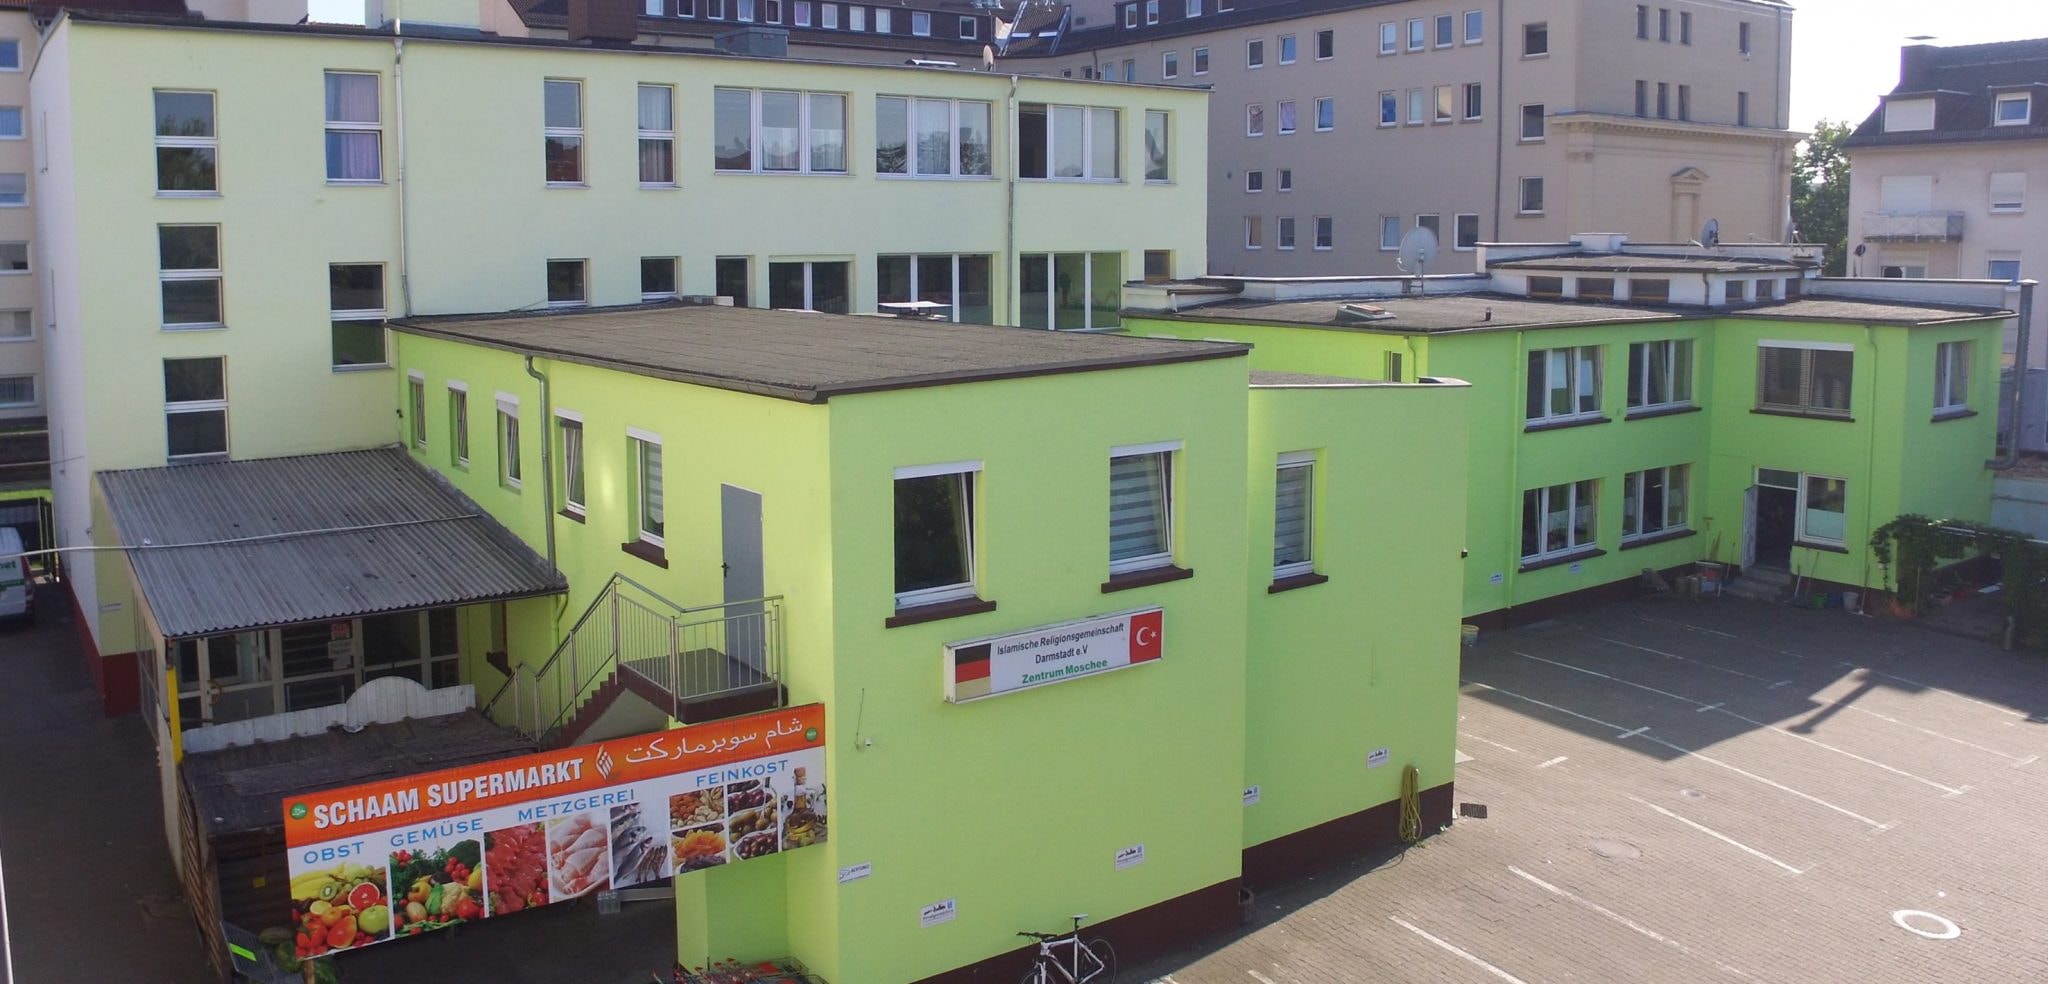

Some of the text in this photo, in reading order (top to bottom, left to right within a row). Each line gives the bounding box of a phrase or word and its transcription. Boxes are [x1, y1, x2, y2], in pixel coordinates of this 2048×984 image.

[997, 622, 1124, 655] Islamische Religionsgemeinschaft
[1022, 658, 1108, 684] Zentrum Moschee
[1035, 648, 1075, 664] Darmstadt
[625, 717, 803, 764] شام سوبرماركت
[696, 760, 788, 787] FEINKOST
[313, 758, 585, 830] SCHAAM SUPERMARKT
[517, 788, 636, 823] METZGEREI
[390, 818, 484, 848] GEMÜSE
[303, 841, 365, 865] OBST
